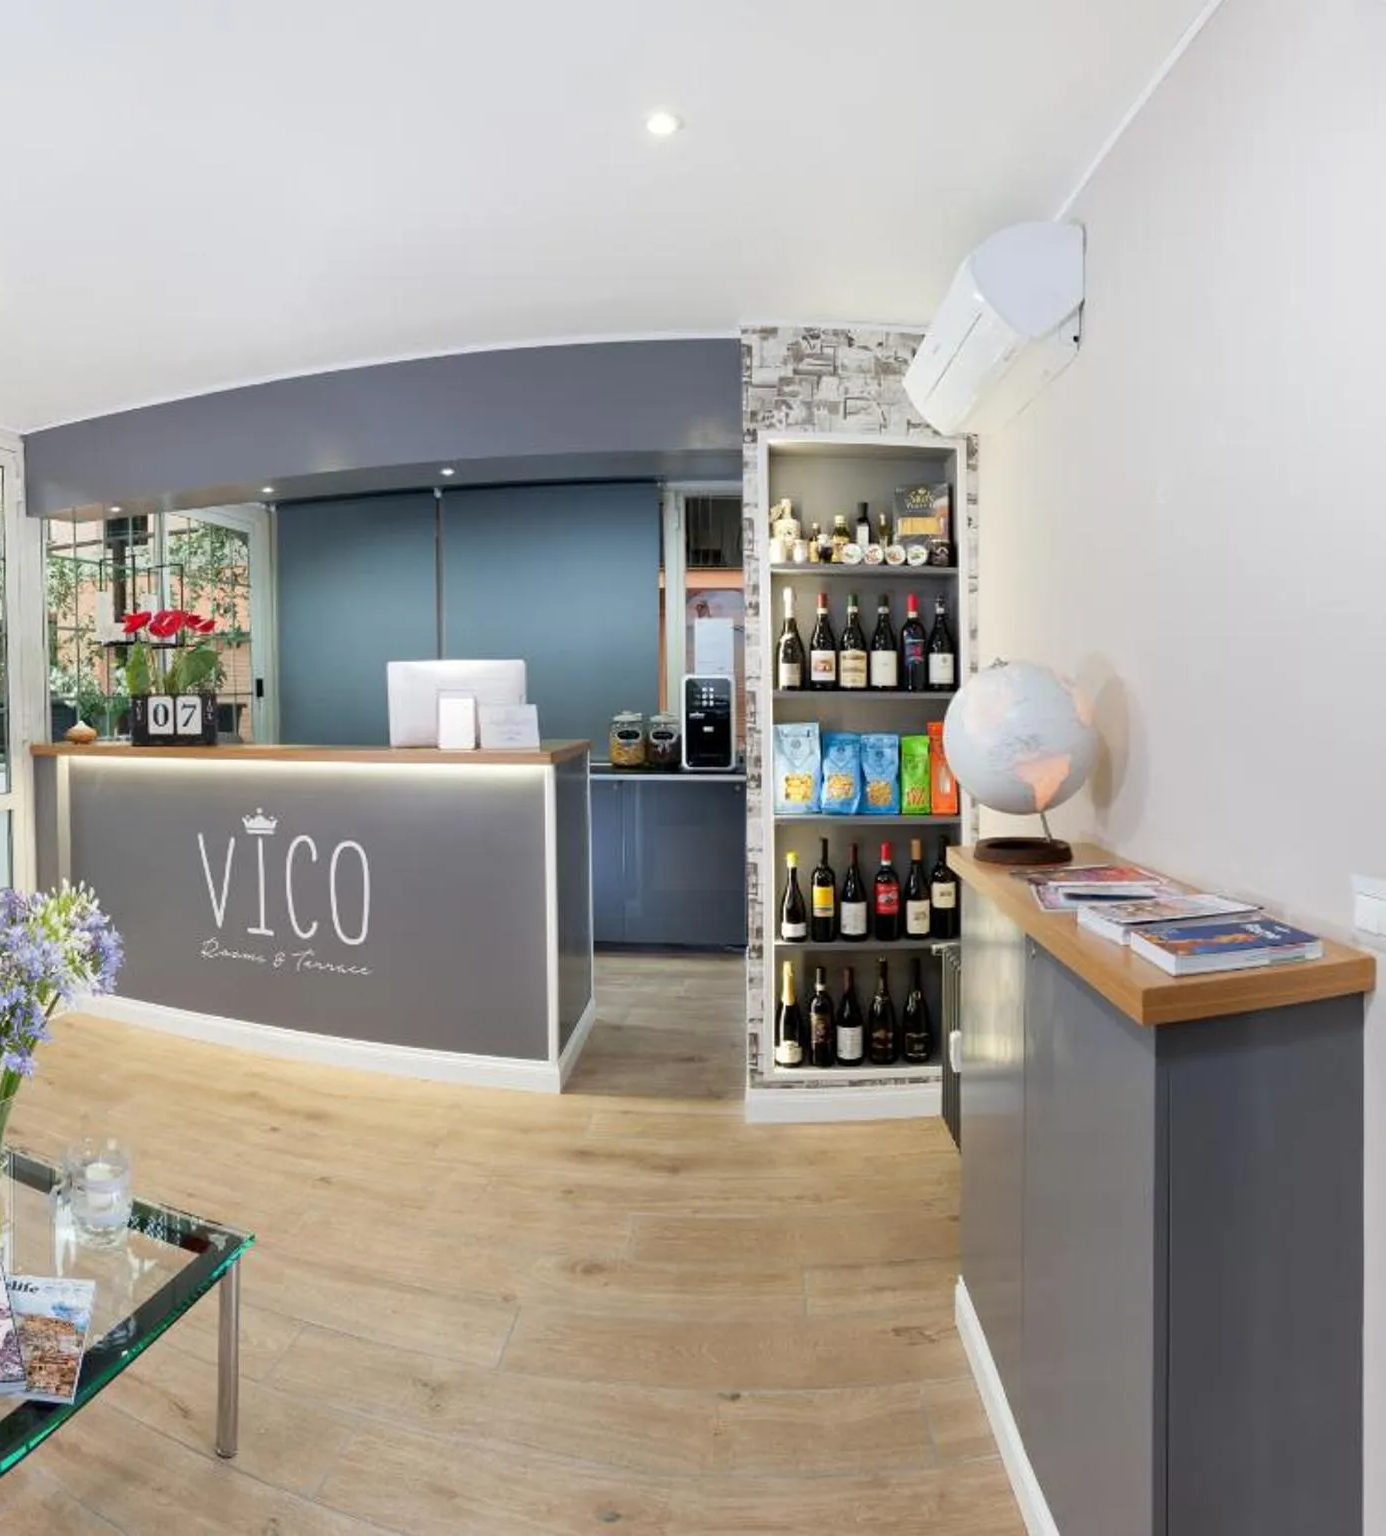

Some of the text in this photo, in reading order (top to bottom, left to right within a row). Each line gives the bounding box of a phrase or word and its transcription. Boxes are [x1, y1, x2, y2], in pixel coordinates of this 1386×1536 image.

[152, 702, 197, 728] 07
[197, 832, 371, 946] VICO
[290, 949, 374, 976] Terrace
